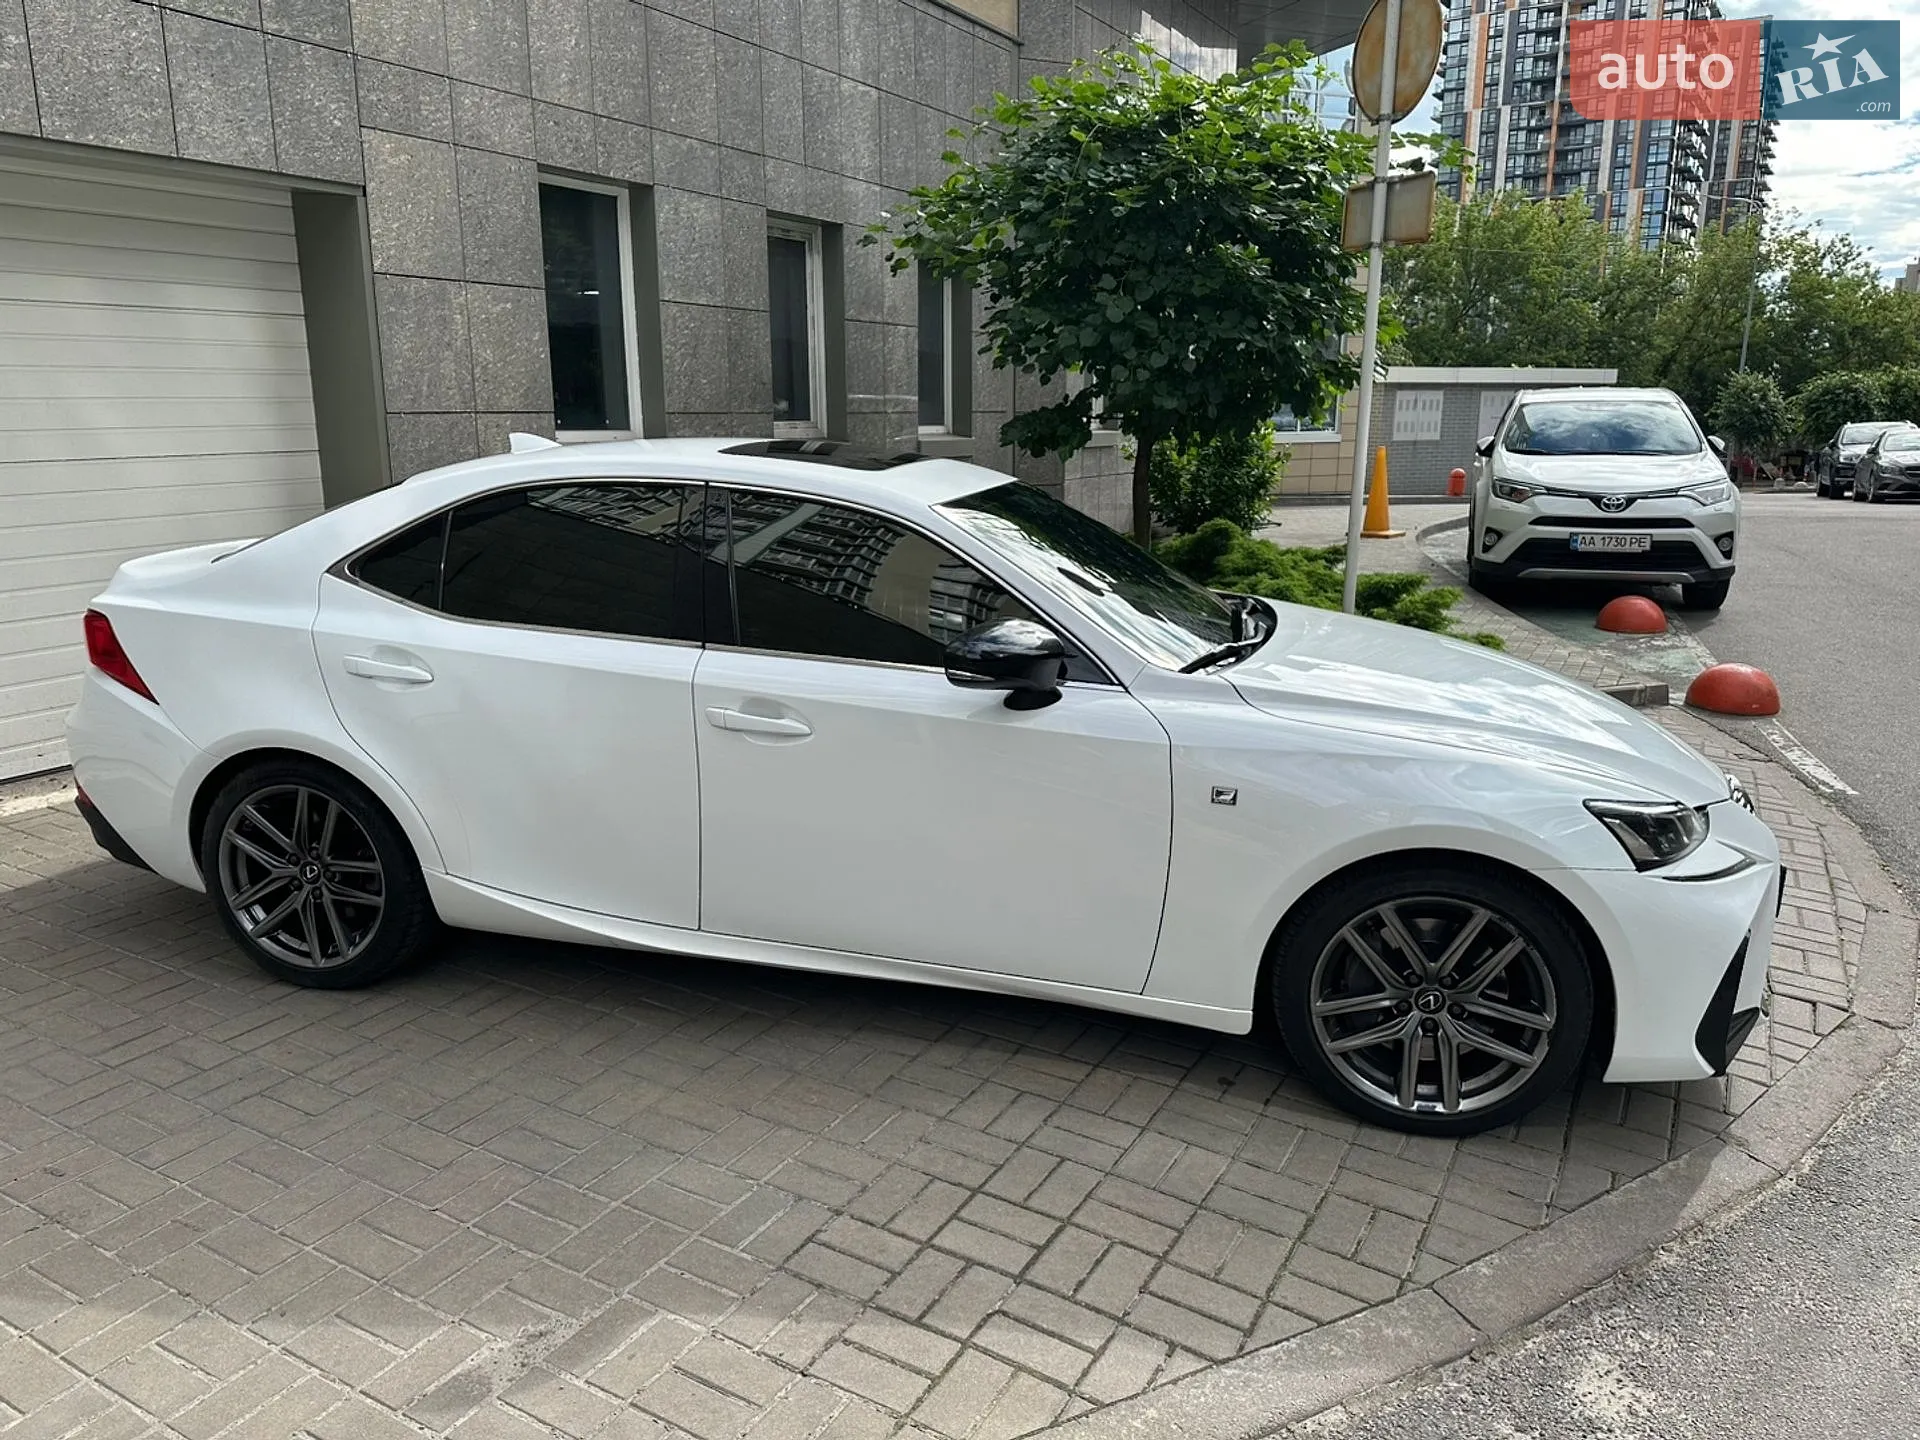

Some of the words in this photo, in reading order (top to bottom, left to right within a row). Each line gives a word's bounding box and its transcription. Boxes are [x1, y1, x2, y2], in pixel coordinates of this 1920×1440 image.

[1579, 536, 1596, 547] AA
[1600, 536, 1627, 548] 1730
[1629, 537, 1649, 548] PE
